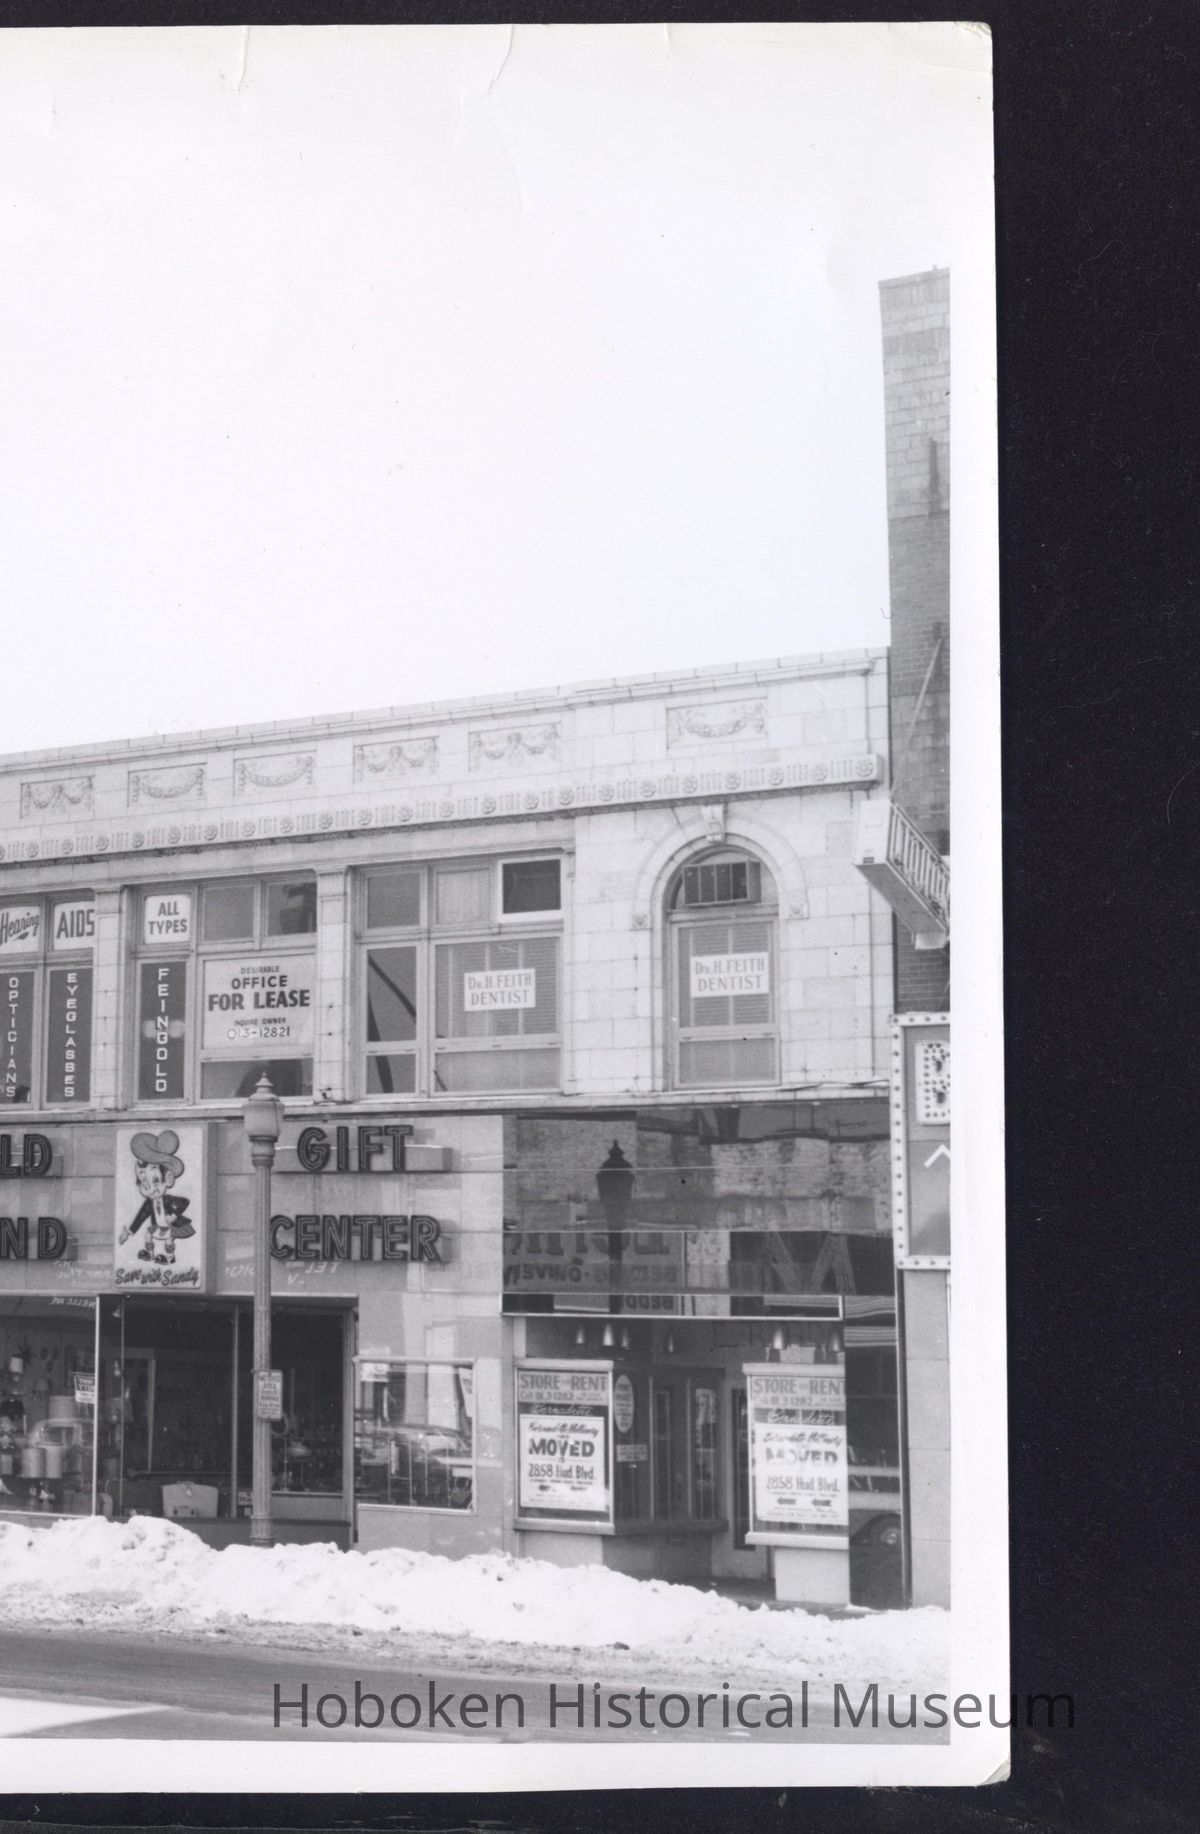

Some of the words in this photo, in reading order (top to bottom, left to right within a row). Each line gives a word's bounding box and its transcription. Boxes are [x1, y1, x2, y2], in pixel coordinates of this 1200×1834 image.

[157, 901, 180, 917] ALL
[56, 908, 95, 940] AIDS
[148, 918, 188, 935] TYPES
[240, 965, 280, 975] DESIRABLE
[230, 974, 289, 990] OFFICE
[697, 974, 762, 993] DENTIST
[207, 992, 245, 1012] FOR
[253, 989, 311, 1009] LEASE
[470, 989, 529, 1006] DENTIST
[154, 967, 171, 1093] FEINGOLD
[261, 1017, 287, 1025] OWNER
[4, 976, 20, 1098] OPTICIANS
[63, 972, 79, 1098] EYEGLASSES
[297, 1124, 414, 1173] GIFT
[270, 1213, 443, 1262] CENTER
[115, 1267, 142, 1286] Save
[141, 1267, 163, 1287] with
[161, 1266, 200, 1287] Sandy
[519, 1374, 561, 1391] STORE
[571, 1374, 609, 1392] RENT
[753, 1378, 798, 1395] STORE
[528, 1437, 596, 1459] MOVED
[528, 1463, 554, 1479] 2858
[765, 1474, 793, 1491] 2858
